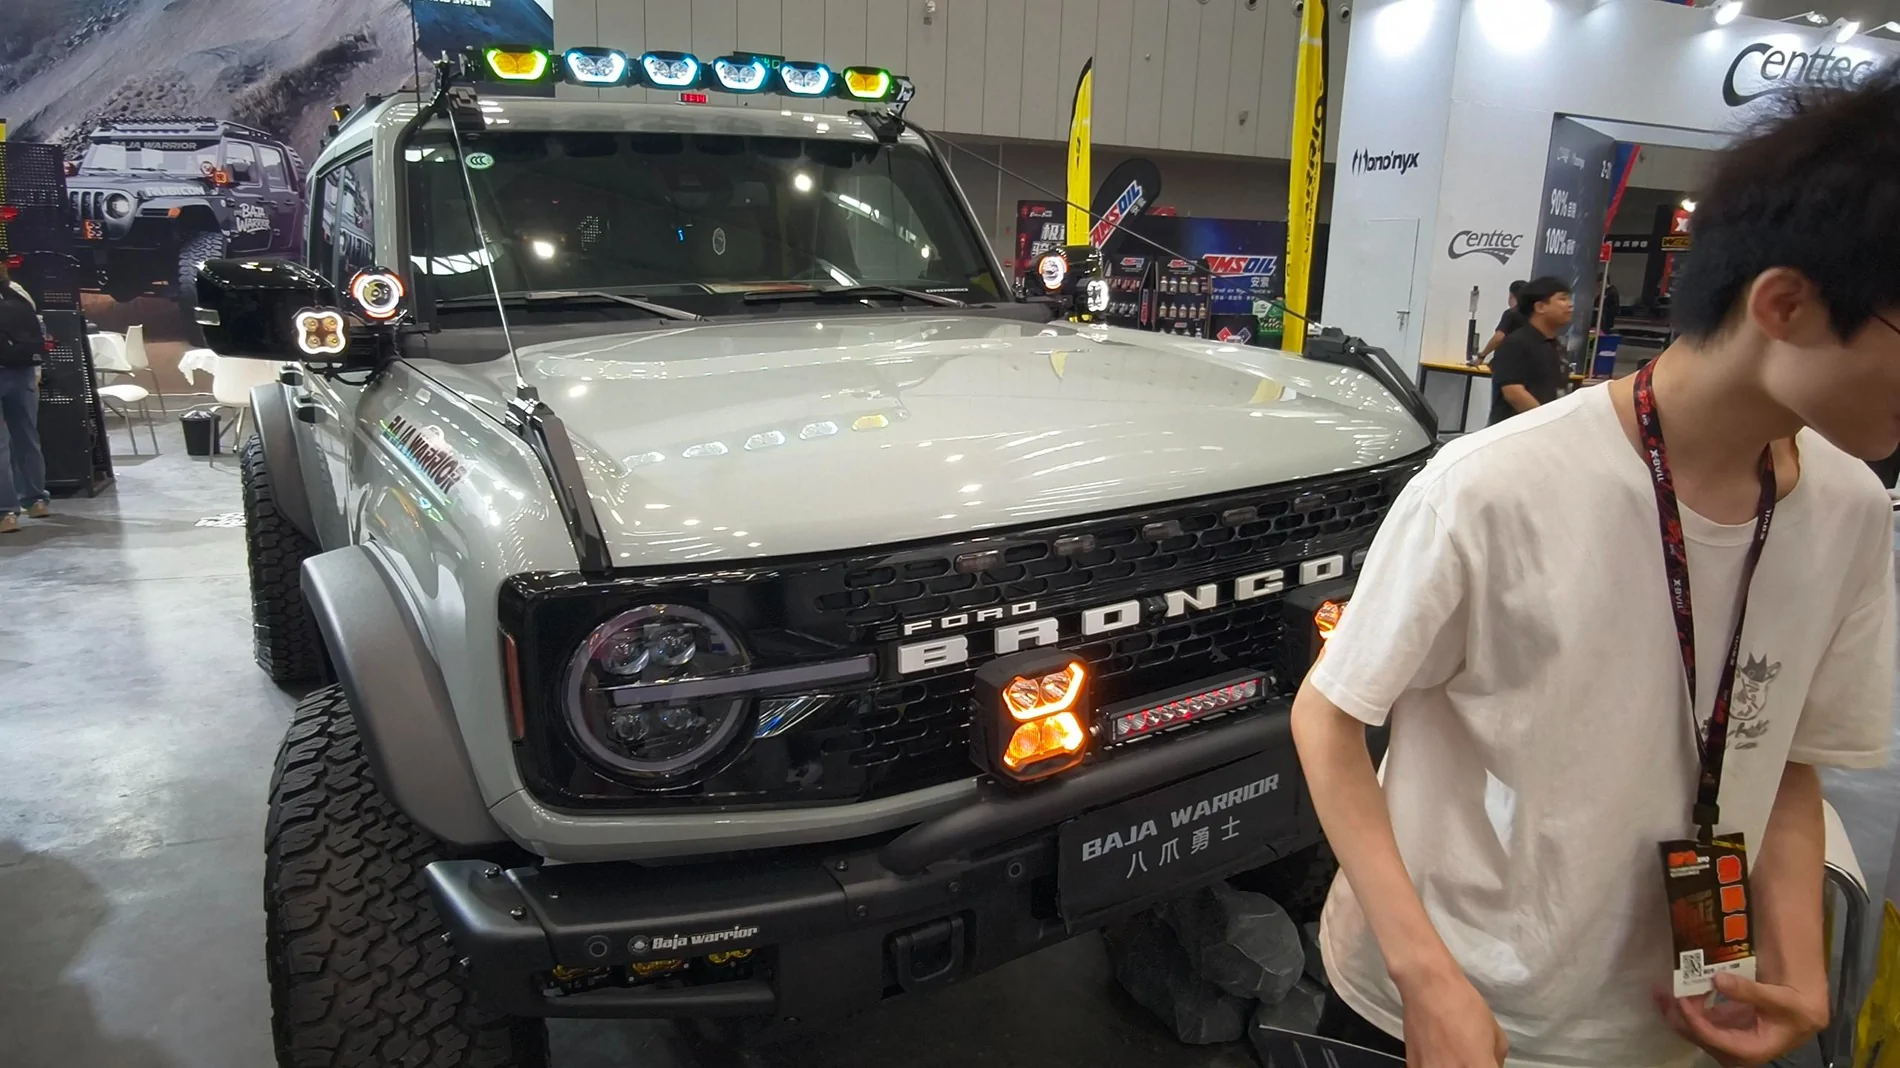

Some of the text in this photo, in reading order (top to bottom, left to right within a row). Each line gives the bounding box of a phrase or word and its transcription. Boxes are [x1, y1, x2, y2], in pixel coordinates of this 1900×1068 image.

[1723, 43, 1875, 107] Centtec
[143, 142, 197, 150] WARRIOR
[1550, 188, 1569, 217] 90%
[1448, 230, 1524, 265] Centtec
[1545, 228, 1568, 255] 100%
[407, 432, 468, 495] WARRIOR
[898, 554, 1344, 675] BRONCO
[904, 601, 1037, 636] FORD
[1082, 773, 1280, 862] BAJA WARRIOR
[1126, 816, 1241, 880] 八爪勇士
[652, 925, 758, 950] Baja warrior
